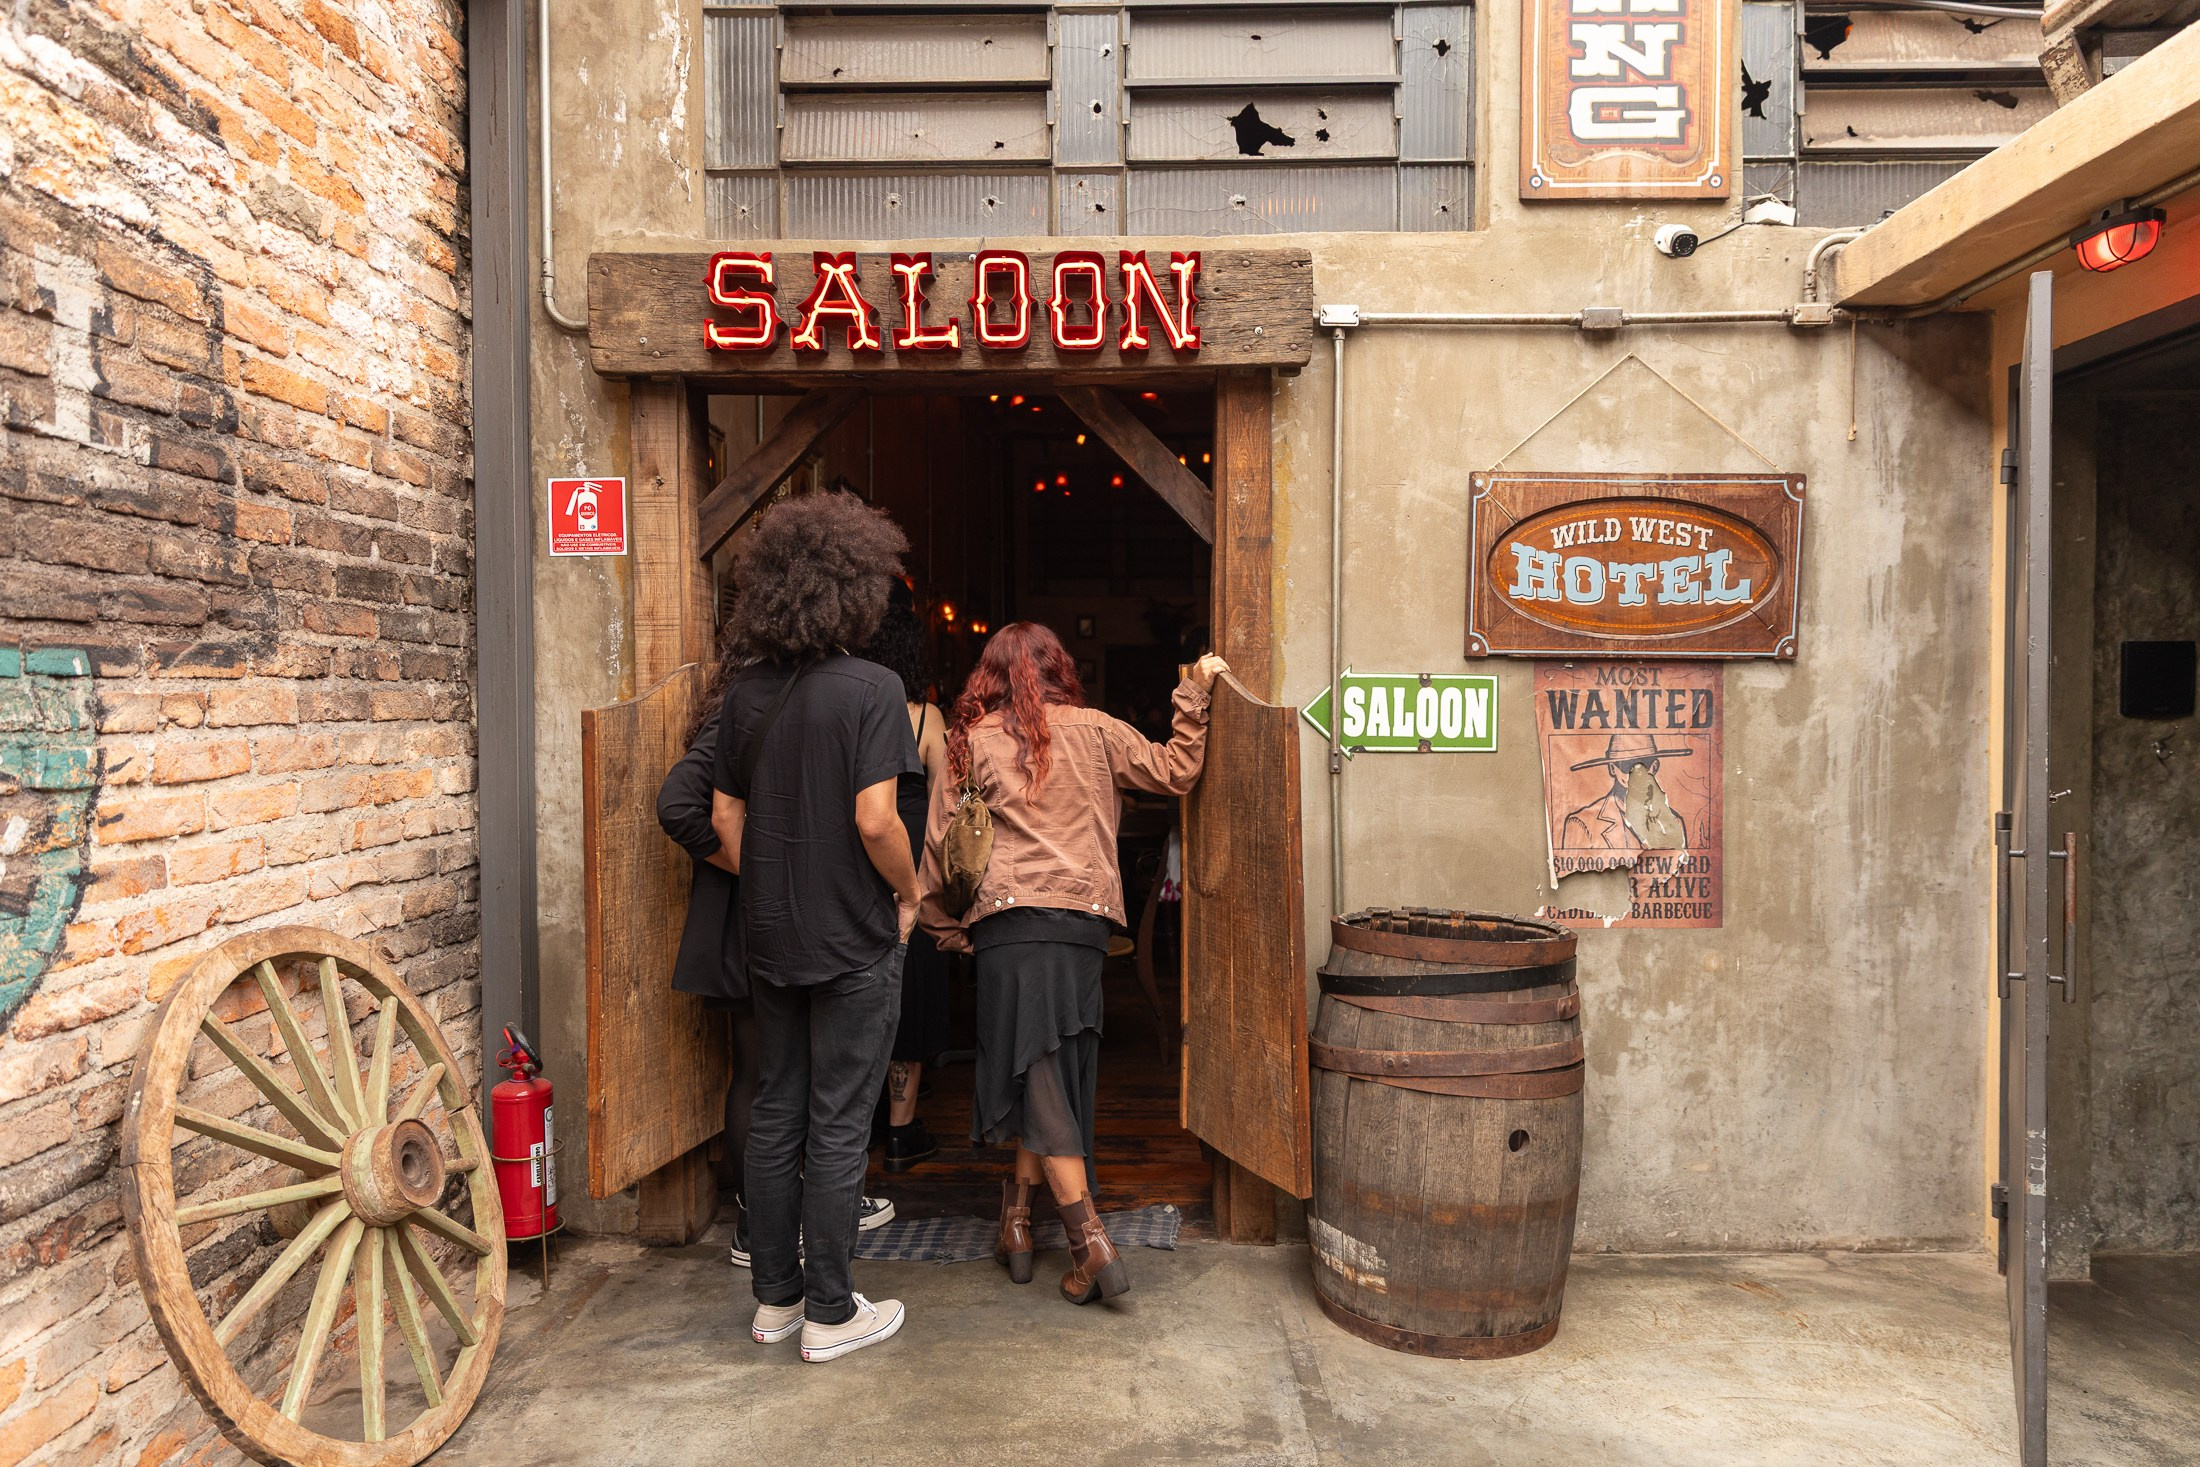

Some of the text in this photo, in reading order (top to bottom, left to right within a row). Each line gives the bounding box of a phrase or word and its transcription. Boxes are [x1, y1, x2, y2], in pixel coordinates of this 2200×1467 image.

[1568, 0, 1687, 141] NG
[703, 249, 1202, 354] SALOON
[1550, 516, 1714, 551] WILD WEST
[1508, 541, 1753, 607] HOTEL
[1595, 666, 1663, 686] MOST
[1343, 686, 1489, 739] SALOON
[1546, 689, 1714, 730] WANTED
[1647, 877, 1711, 899] ALIVE
[1631, 902, 1713, 919] BARBECUE
